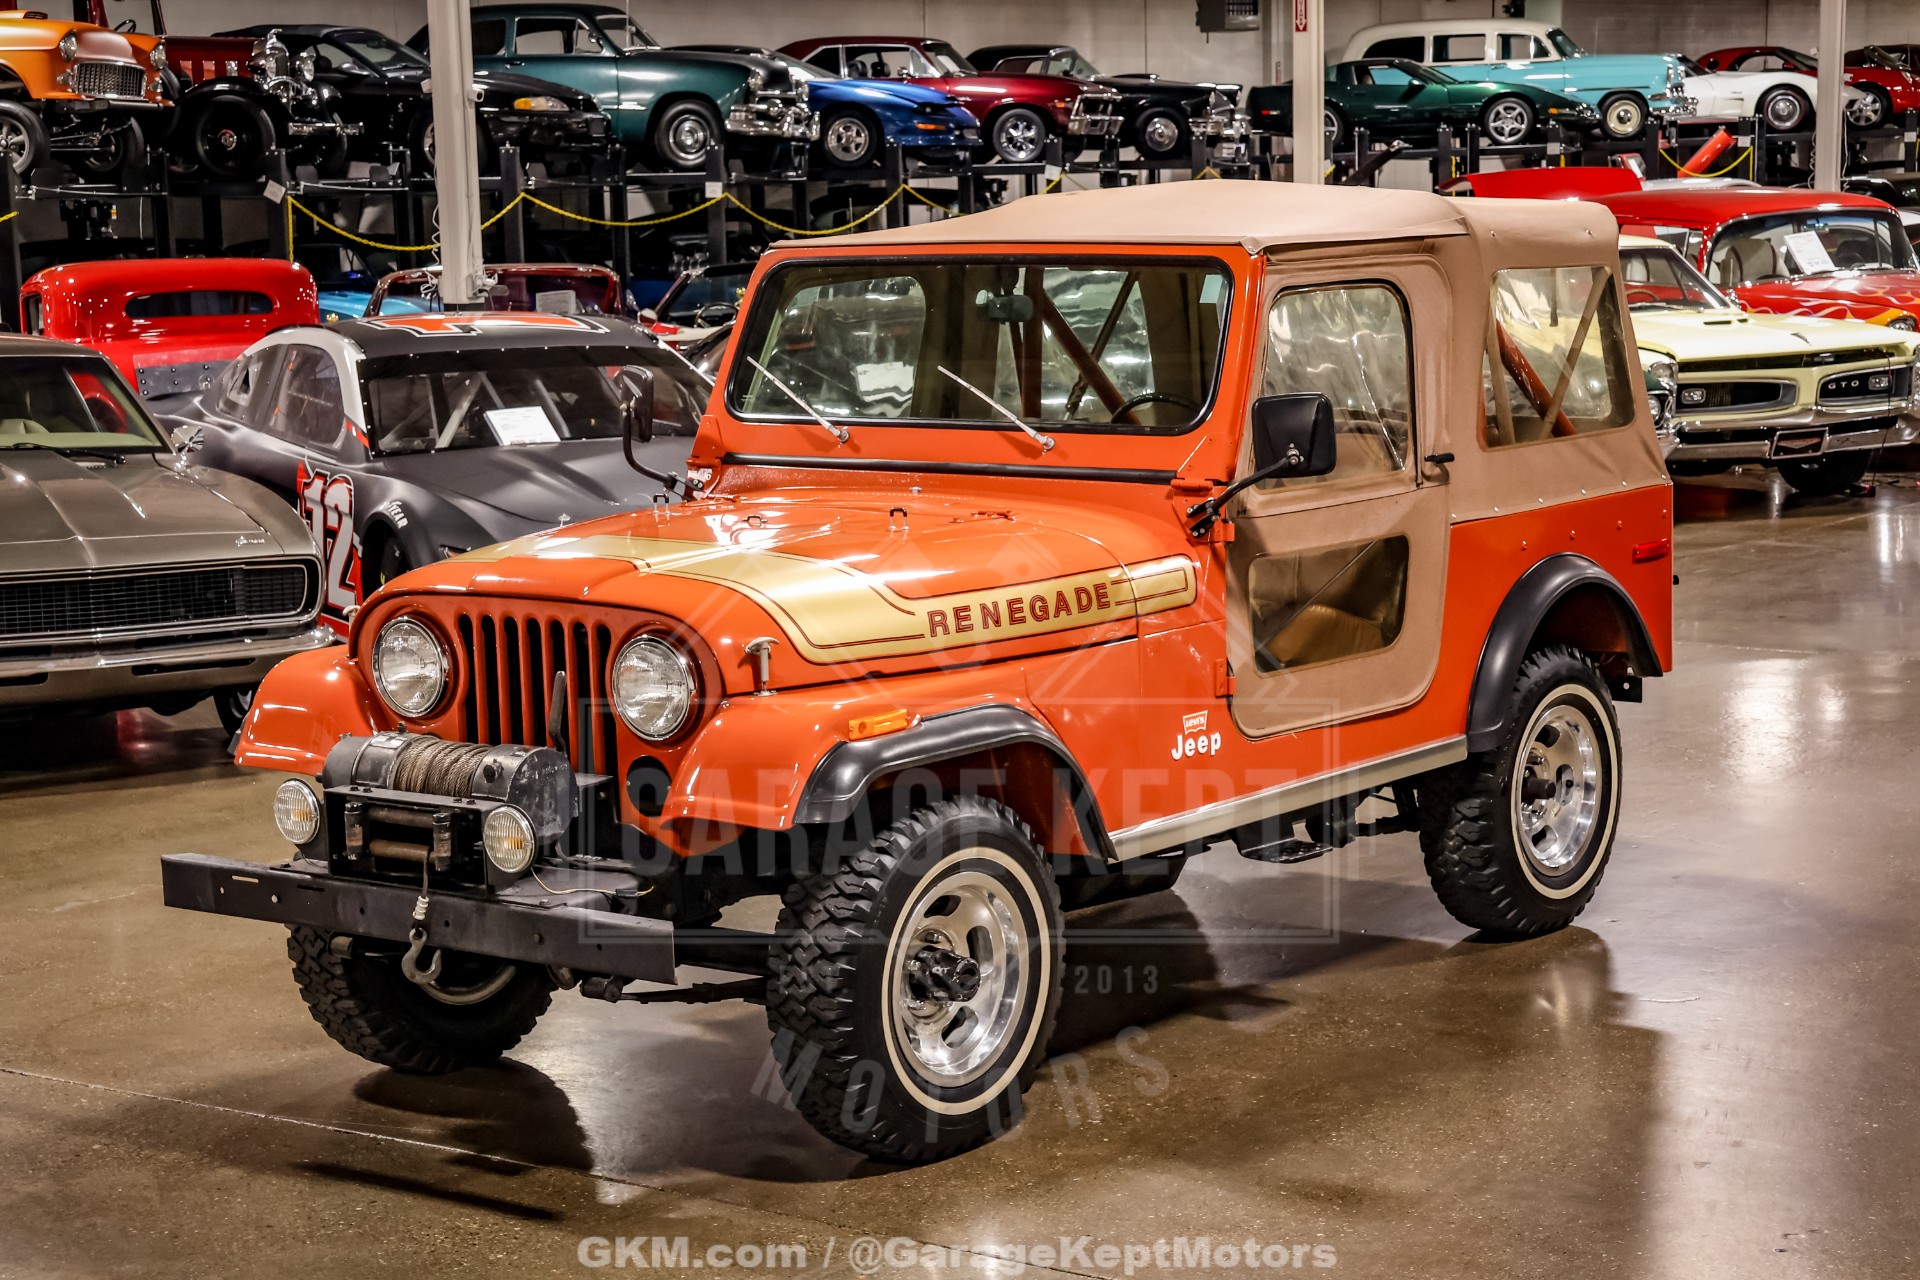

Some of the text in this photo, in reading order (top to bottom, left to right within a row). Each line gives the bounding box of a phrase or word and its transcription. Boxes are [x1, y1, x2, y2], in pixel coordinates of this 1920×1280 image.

[1828, 380, 1859, 389] GTO
[302, 474, 357, 607] 12
[927, 583, 1111, 638] RENEGADE
[1171, 732, 1222, 760] Jeep
